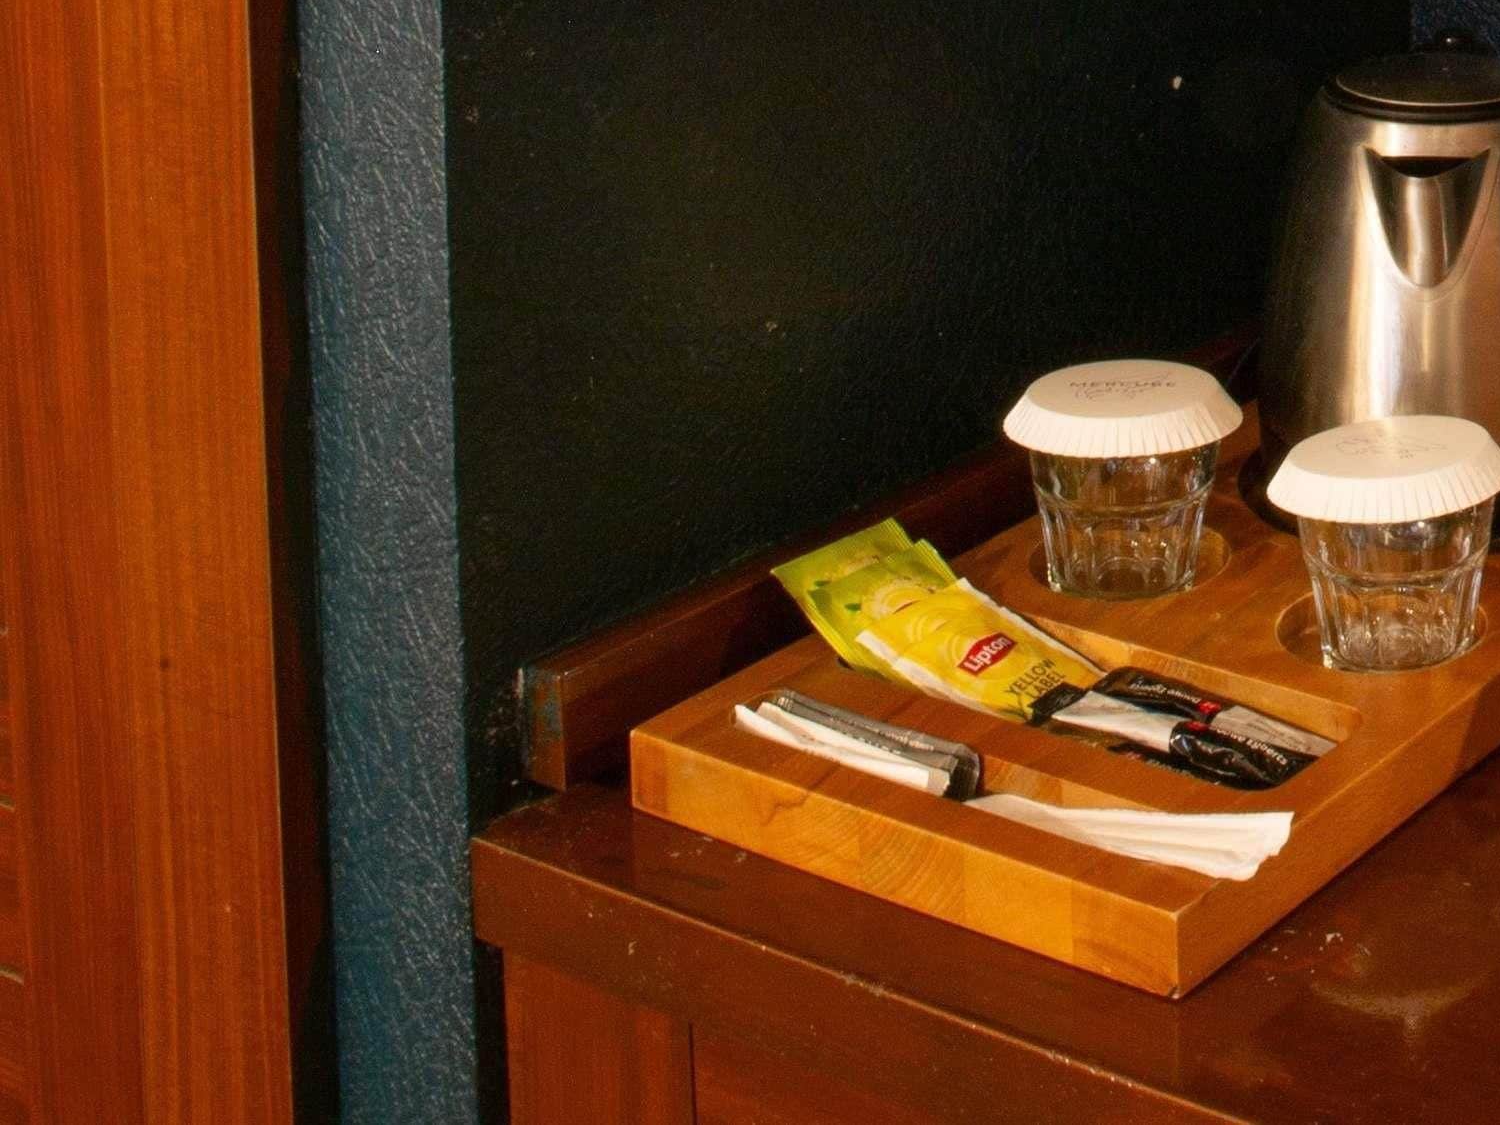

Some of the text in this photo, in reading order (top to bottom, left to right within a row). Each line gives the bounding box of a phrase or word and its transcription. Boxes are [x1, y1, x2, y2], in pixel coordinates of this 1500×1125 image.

[963, 636, 1013, 673] Lipton
[1004, 657, 1057, 696] YELLOW
[1025, 670, 1067, 701] LABEL
